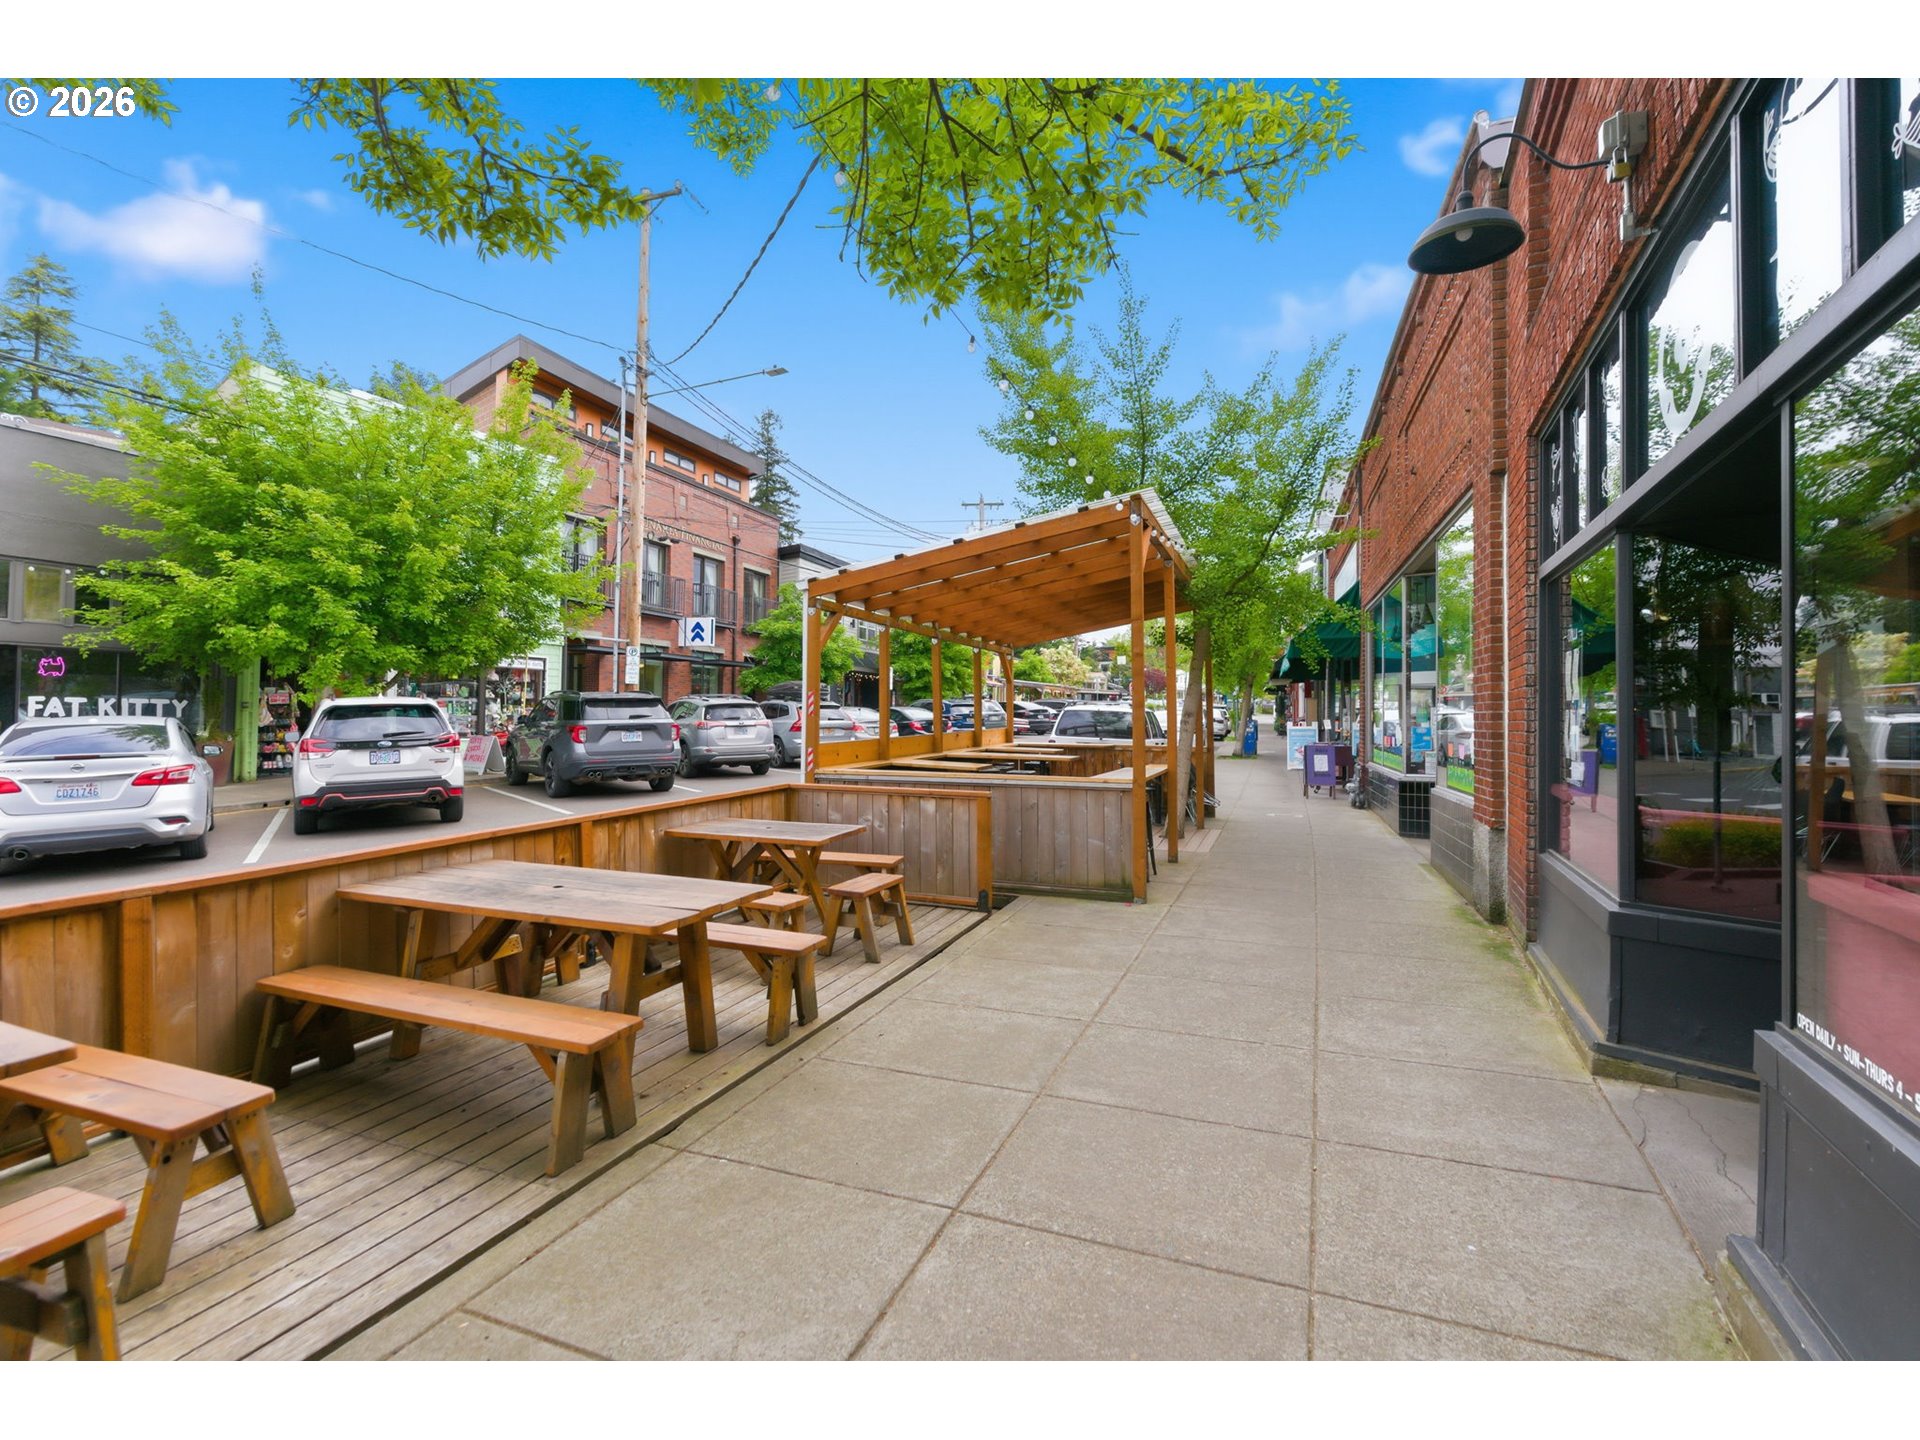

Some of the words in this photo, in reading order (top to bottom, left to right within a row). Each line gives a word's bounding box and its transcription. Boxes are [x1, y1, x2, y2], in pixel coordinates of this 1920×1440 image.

[27, 695, 88, 718] FAT
[98, 697, 189, 718] KITTY
[1797, 1012, 1815, 1037] OPEN
[1816, 1024, 1836, 1051] DAILY
[1843, 1044, 1894, 1093] SUN-THURS
